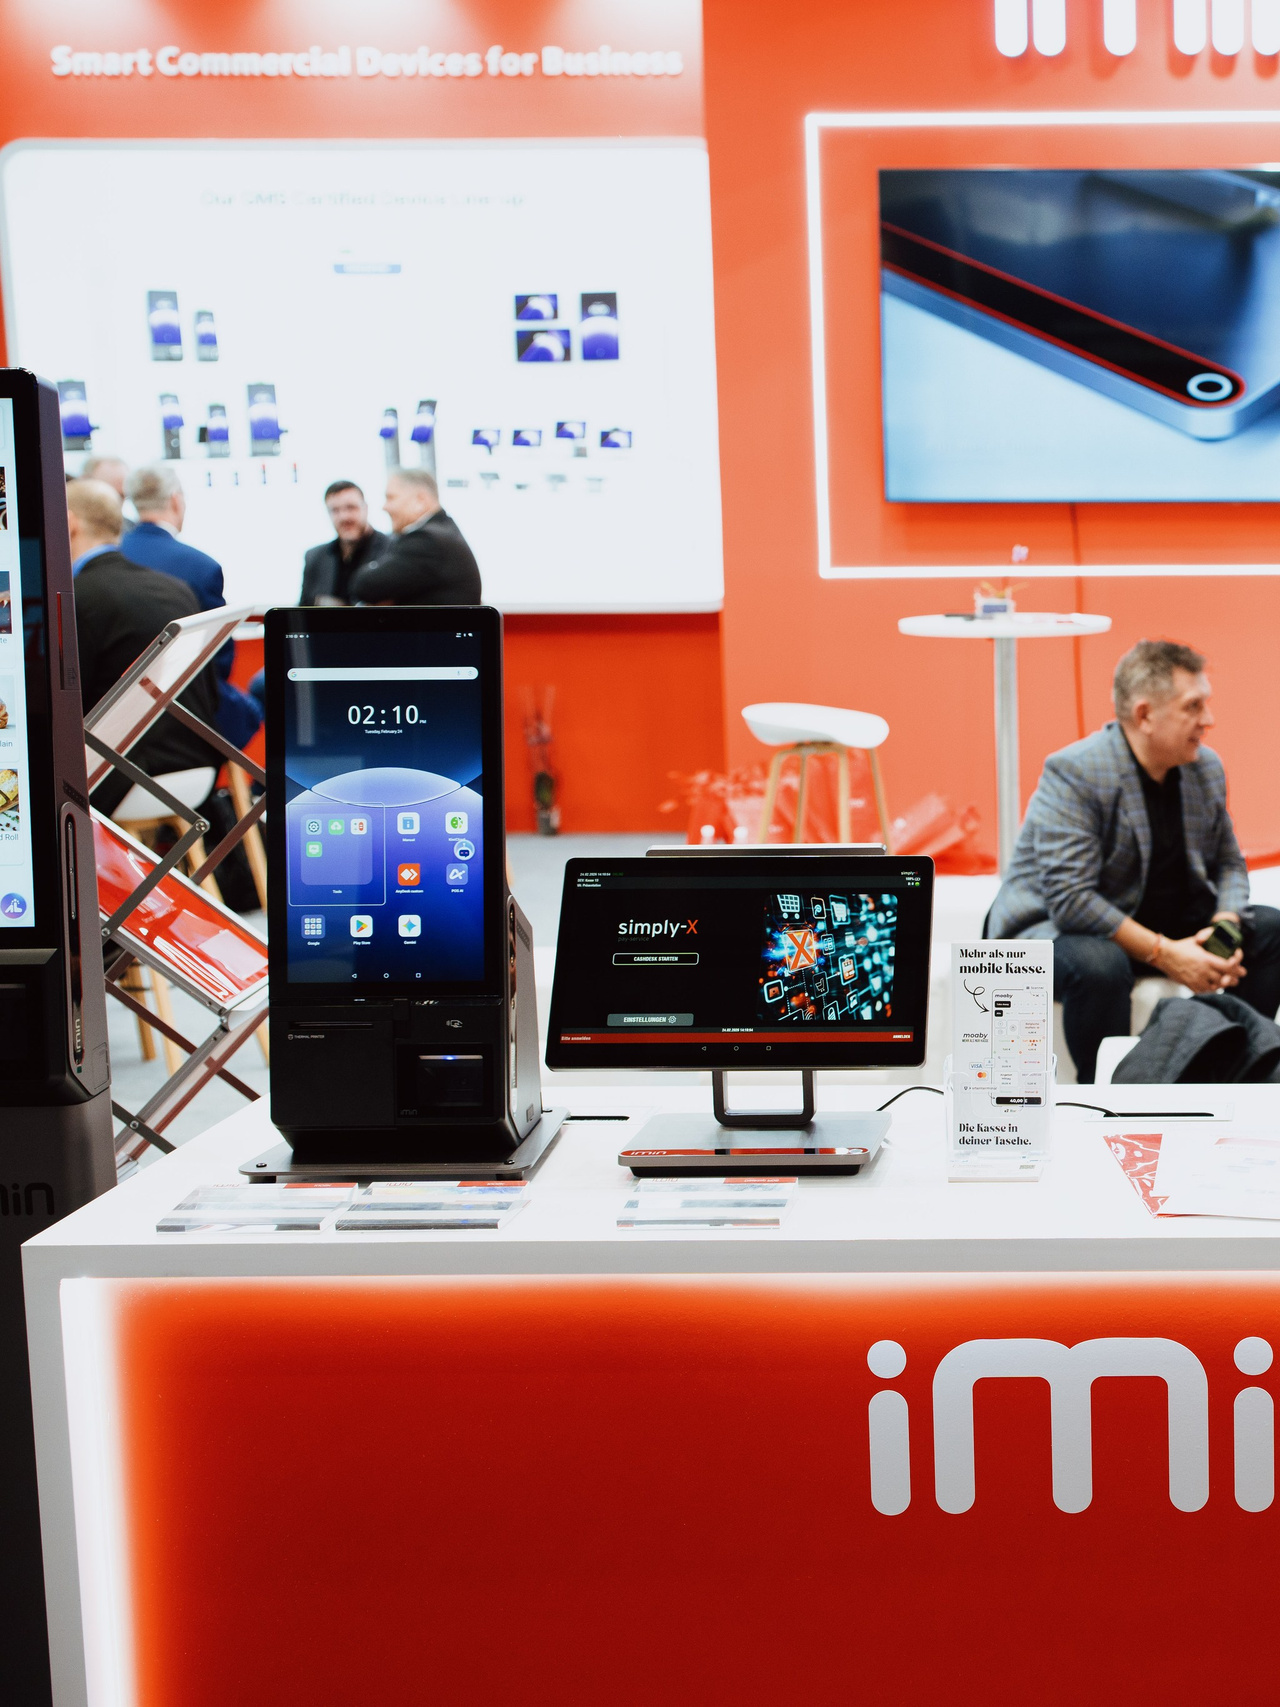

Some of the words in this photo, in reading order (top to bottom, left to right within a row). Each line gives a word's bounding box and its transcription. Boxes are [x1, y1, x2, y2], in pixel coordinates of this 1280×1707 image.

[50, 45, 153, 77] Smart
[156, 45, 351, 77] Commercial
[356, 45, 483, 77] Devices
[485, 44, 539, 77] for
[541, 45, 684, 77] Business
[347, 705, 419, 725] 02:10
[5, 833, 19, 841] Roll
[618, 919, 699, 938] simply-X
[959, 949, 987, 959] Mehr
[988, 949, 1004, 959] als
[1006, 950, 1026, 959] nur
[959, 963, 1003, 974] mobile
[1005, 963, 1046, 974] Kasse.
[623, 1016, 667, 1024] EINSTELLUNGEN
[959, 1123, 975, 1133] Die
[977, 1123, 1007, 1133] Kasse
[1008, 1123, 1018, 1133] in
[958, 1136, 992, 1146] deiner
[994, 1136, 1032, 1146] Tasche.
